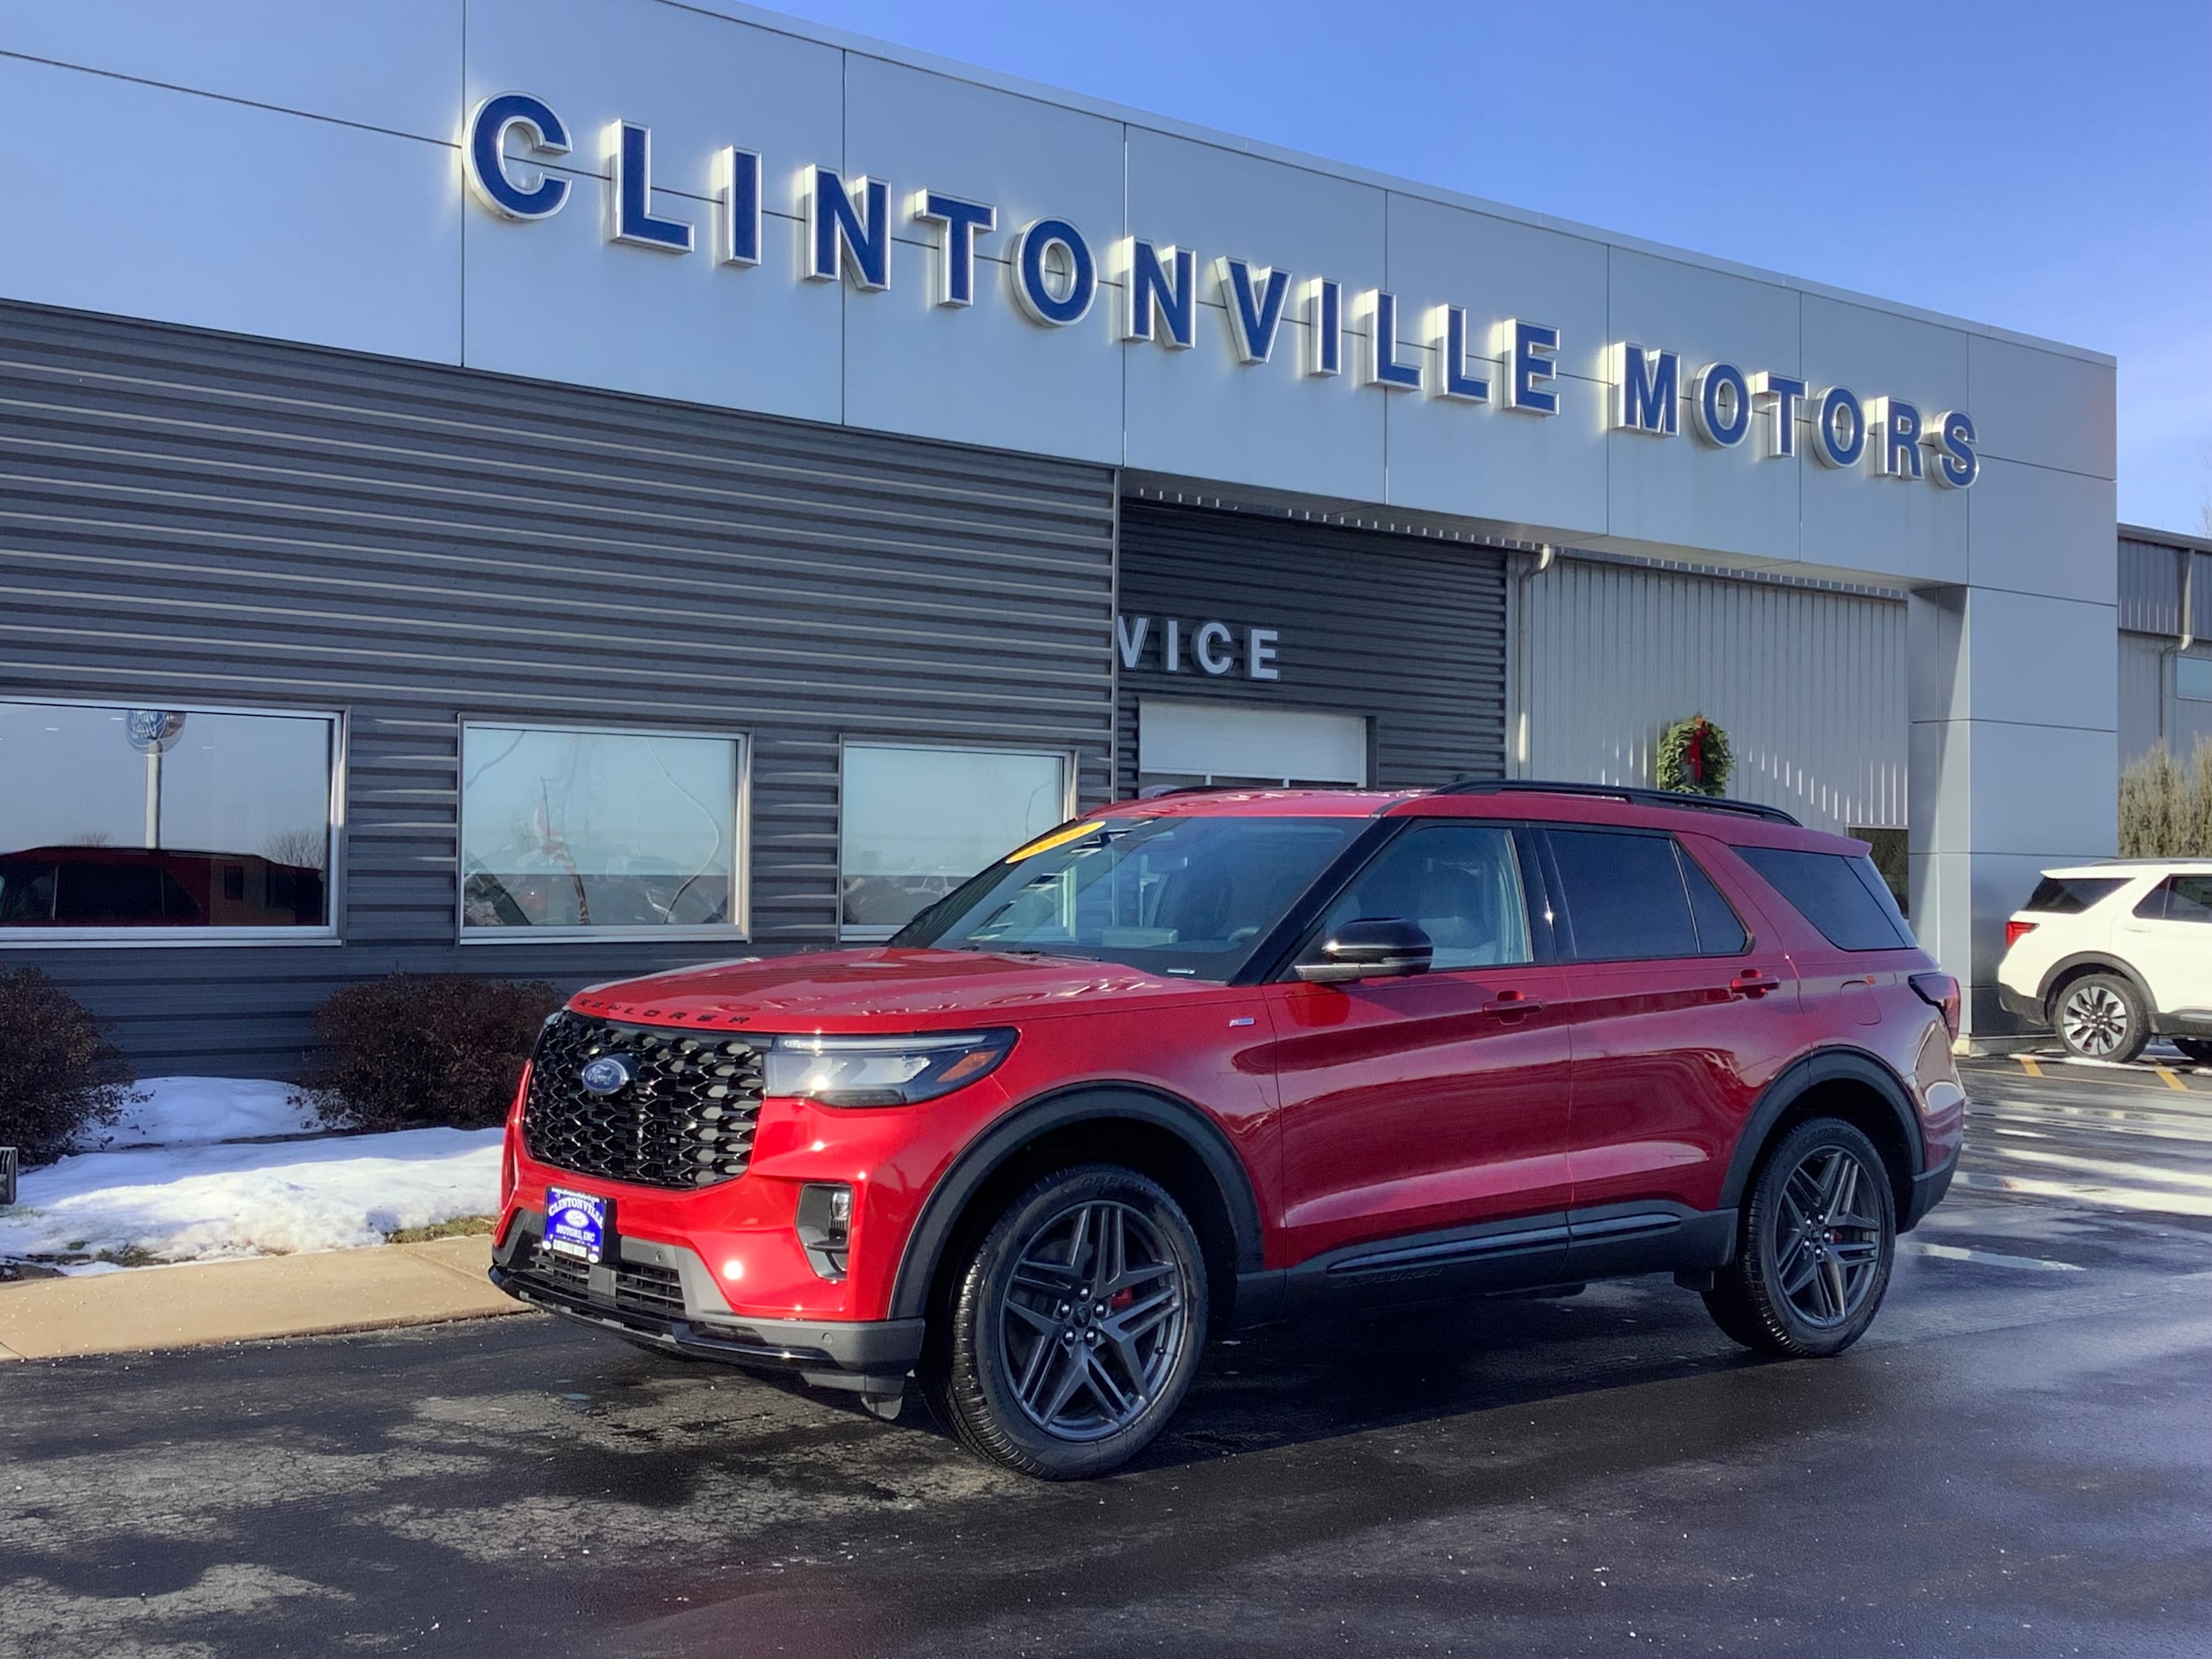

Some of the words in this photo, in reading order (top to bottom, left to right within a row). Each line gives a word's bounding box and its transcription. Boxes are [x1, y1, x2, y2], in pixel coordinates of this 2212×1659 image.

[463, 91, 1560, 417] CLINTONVILLE
[1614, 342, 1980, 488] MOTORS
[1118, 615, 1280, 681] VICE
[585, 1064, 615, 1086] Ford
[549, 1197, 603, 1229] CLINTONVILLE
